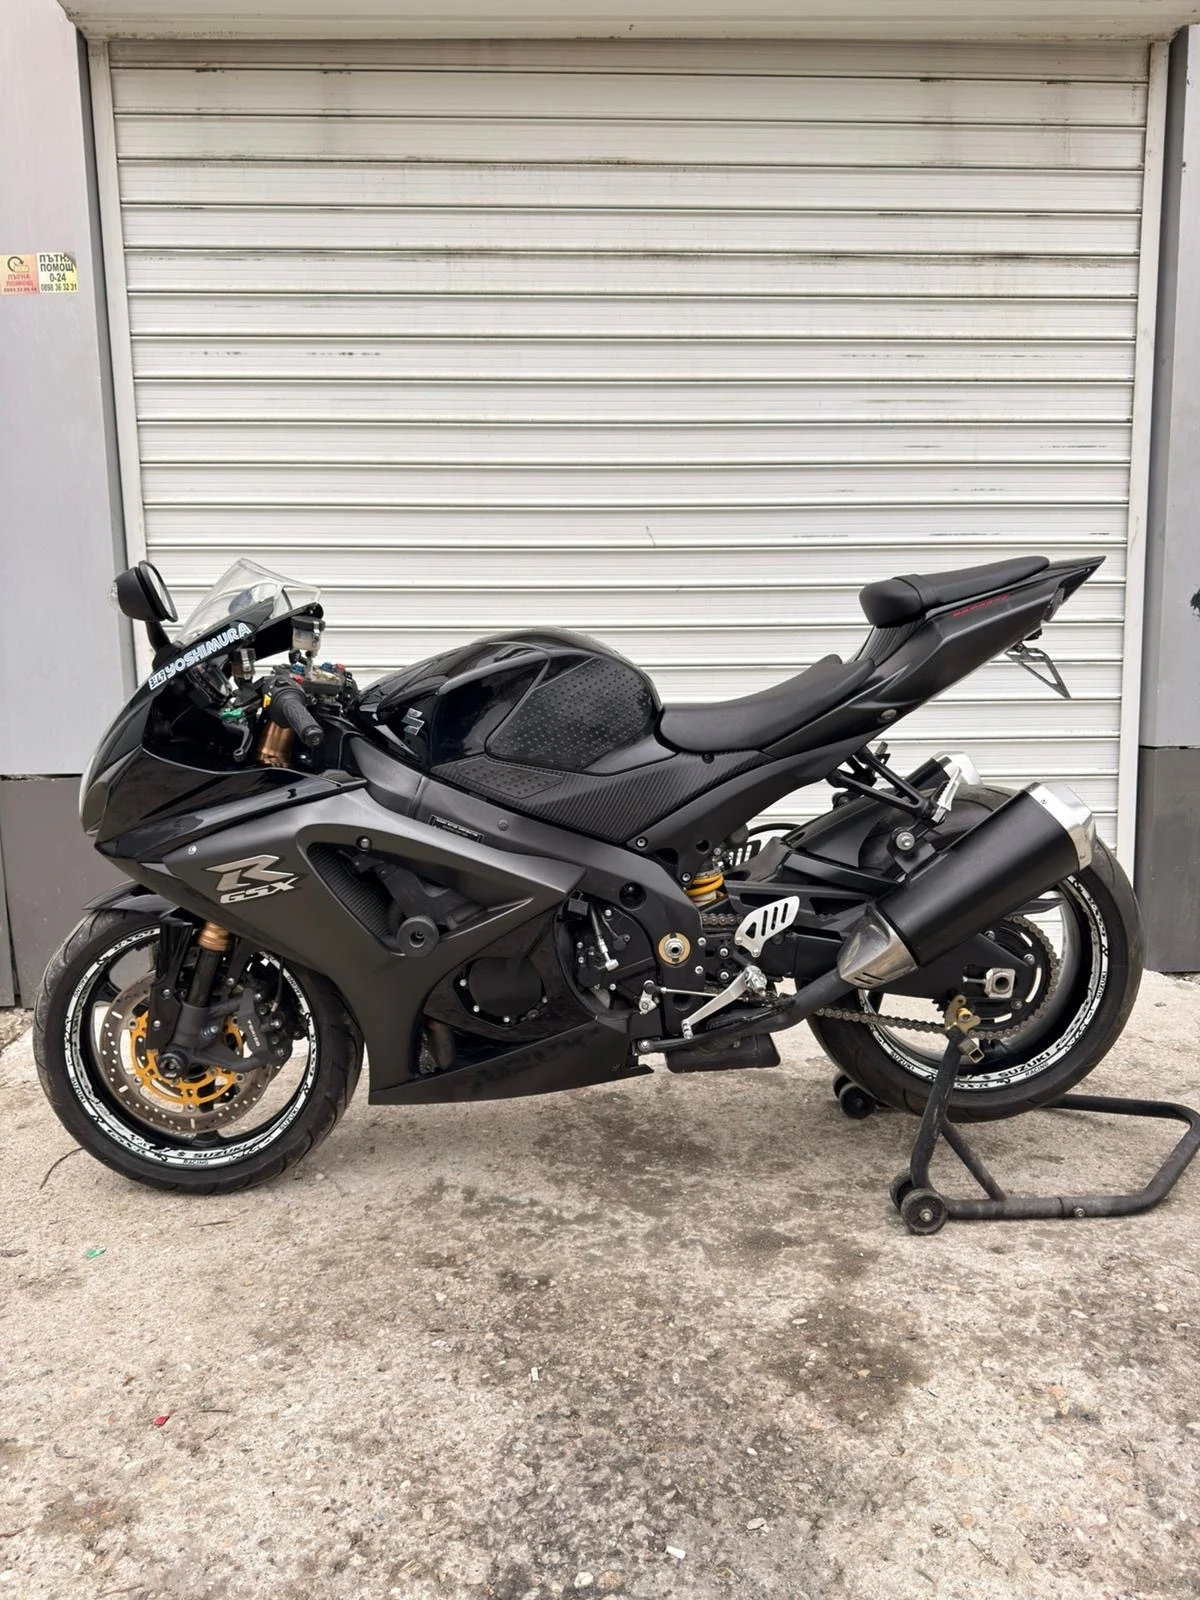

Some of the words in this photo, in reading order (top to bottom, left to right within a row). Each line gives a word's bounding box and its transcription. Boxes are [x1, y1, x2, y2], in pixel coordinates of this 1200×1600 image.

[40, 263, 74, 273] ПОМОЩ
[49, 272, 66, 282] 0-24
[55, 283, 62, 291] 36
[63, 283, 70, 291] 32
[71, 283, 77, 291] 31
[165, 622, 252, 679] YOSHIMURA
[205, 854, 294, 892] R
[998, 1052, 1051, 1077] SUZUKI
[193, 1142, 249, 1158] SUZUKI
